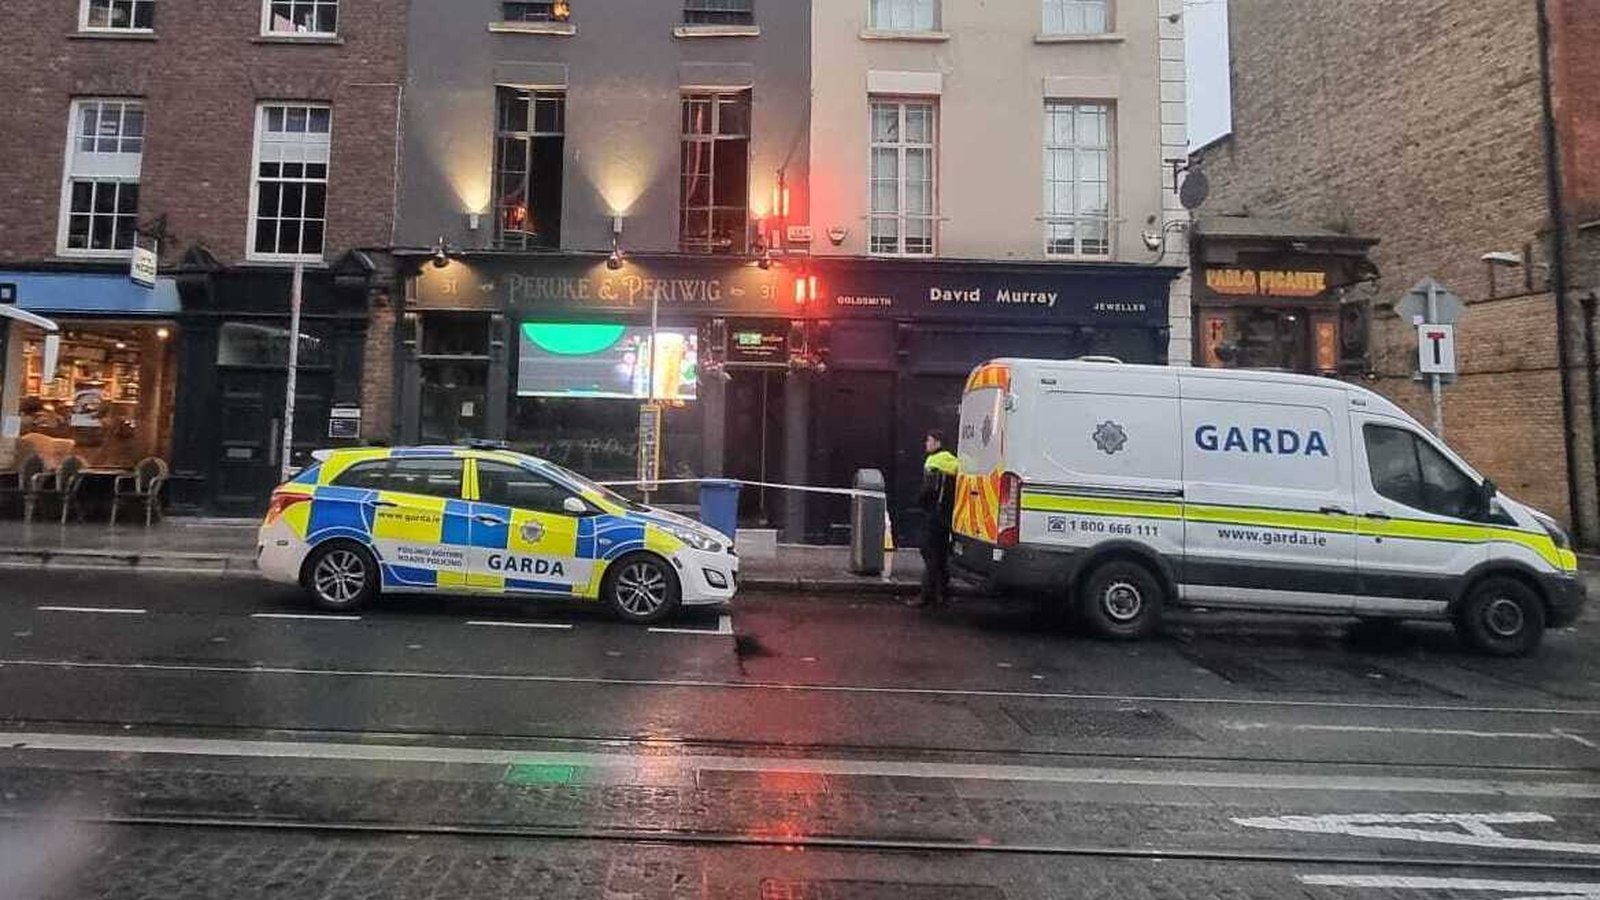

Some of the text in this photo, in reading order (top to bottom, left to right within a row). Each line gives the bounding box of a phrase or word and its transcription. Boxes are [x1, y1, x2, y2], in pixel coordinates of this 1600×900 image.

[508, 274, 591, 304] PERUKE
[598, 279, 619, 300] &
[622, 275, 721, 305] PERIWIG
[929, 287, 1058, 307] David Murray
[836, 295, 892, 307] GOLDSMITH
[1093, 302, 1146, 312] JEWELLER
[1194, 424, 1330, 457] GARDA
[377, 512, 441, 524] www.garda.ie
[1081, 521, 1104, 532] 800
[1108, 523, 1132, 534] 666
[1137, 525, 1159, 536] 111
[1217, 528, 1327, 547] www.garda.ie
[487, 554, 565, 577] GARDA
